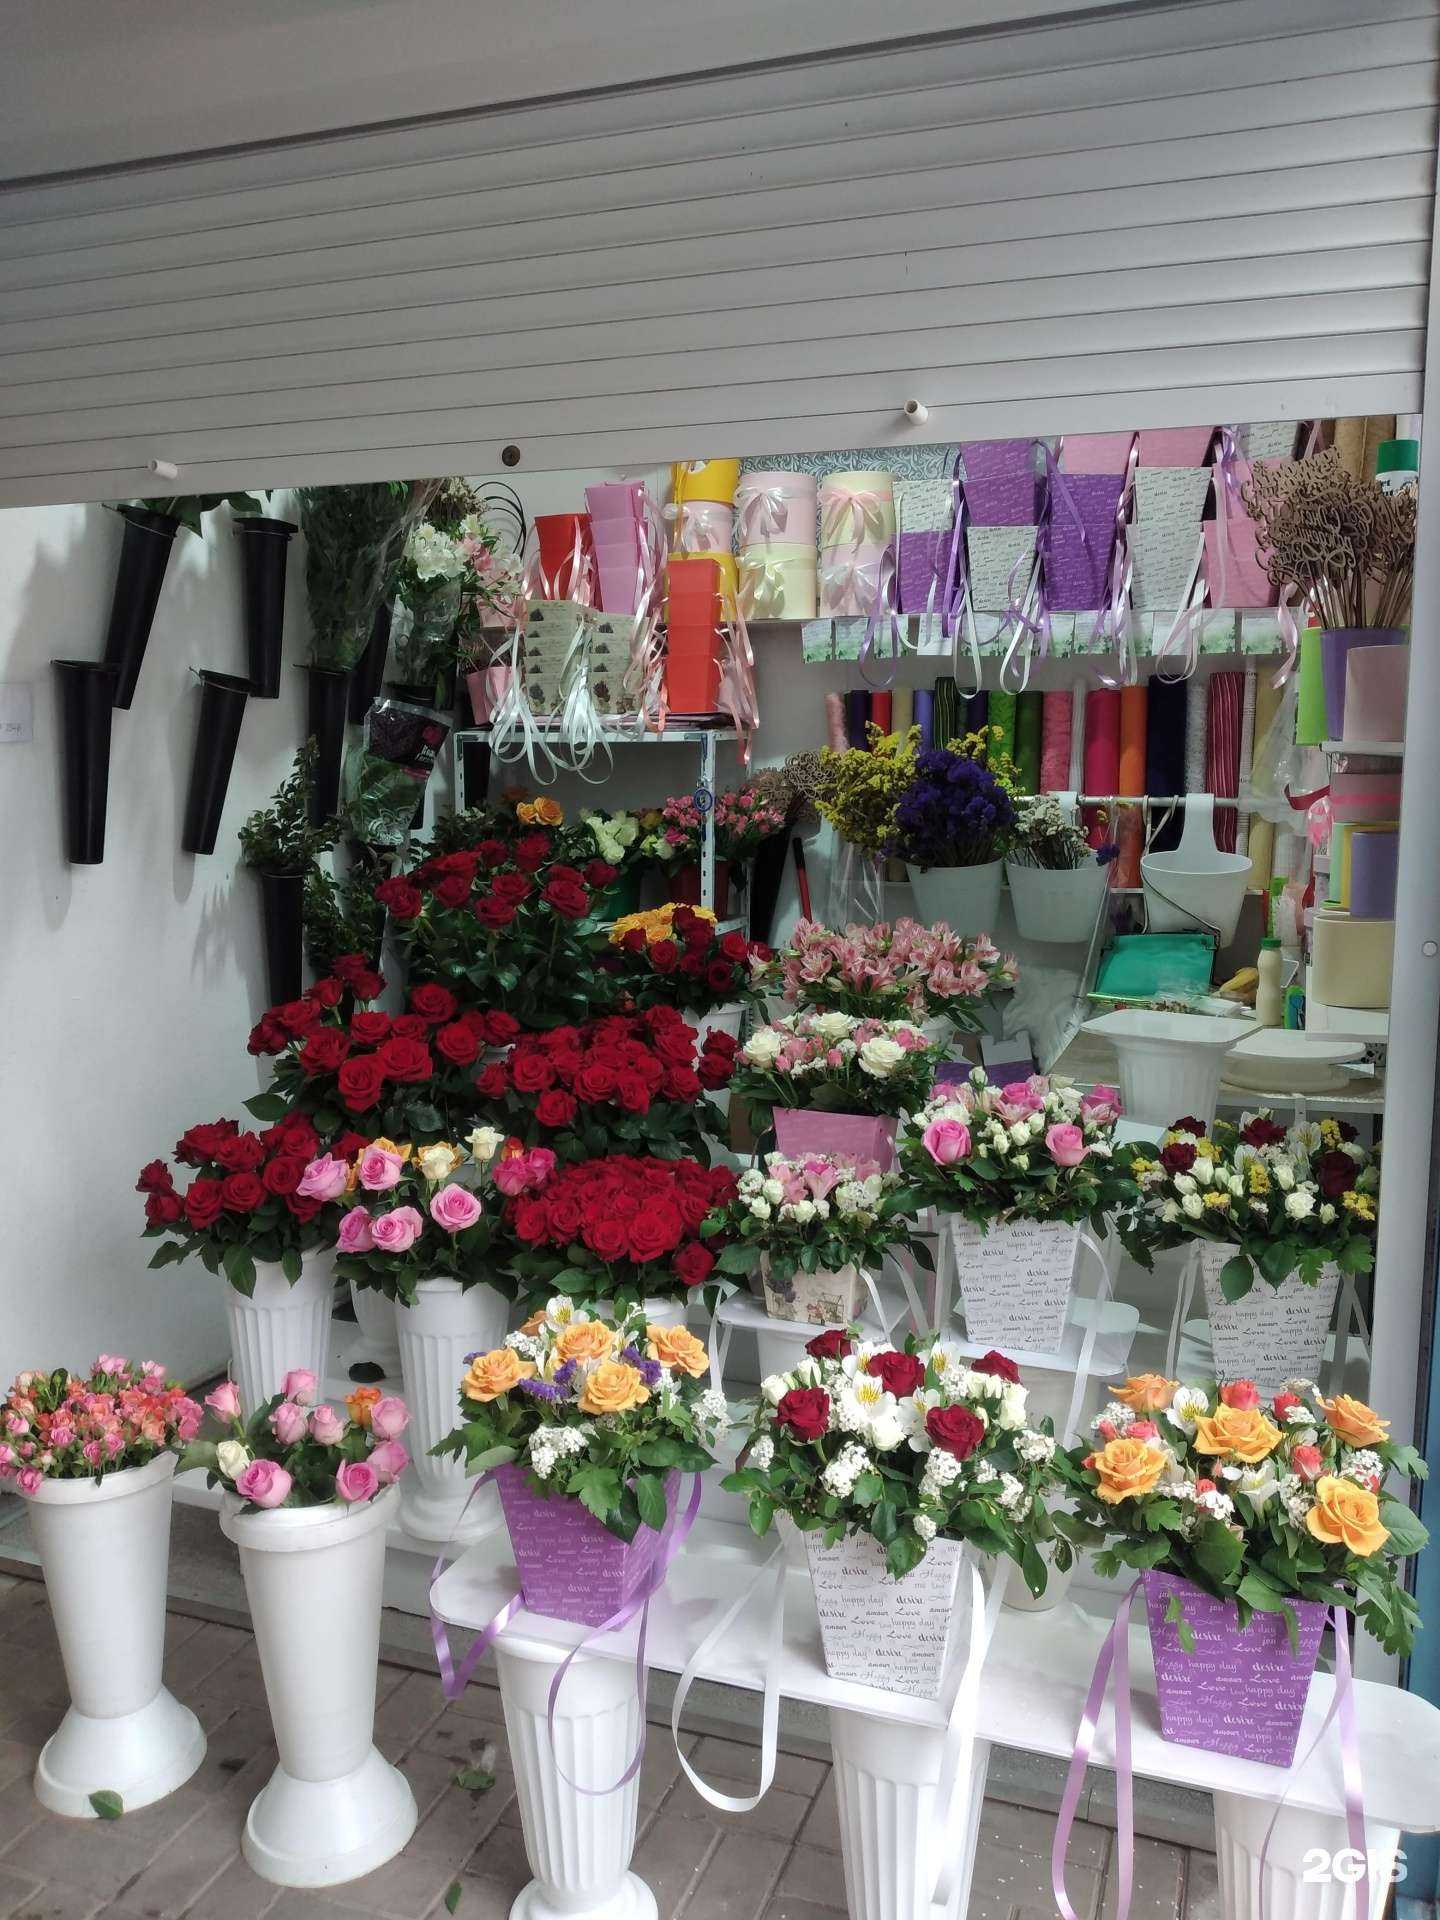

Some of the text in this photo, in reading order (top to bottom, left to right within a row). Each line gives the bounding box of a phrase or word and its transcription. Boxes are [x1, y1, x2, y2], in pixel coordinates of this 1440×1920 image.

[927, 1556, 953, 1566] Love
[895, 1607, 921, 1616] Love
[850, 1616, 876, 1625] Love
[886, 1630, 912, 1639] Love
[1231, 1642, 1262, 1653] Love
[895, 1674, 921, 1684] Love
[1249, 1673, 1281, 1684] Love
[1196, 1681, 1227, 1691] Love
[1237, 1697, 1268, 1708] Love
[1243, 1743, 1274, 1754] Love
